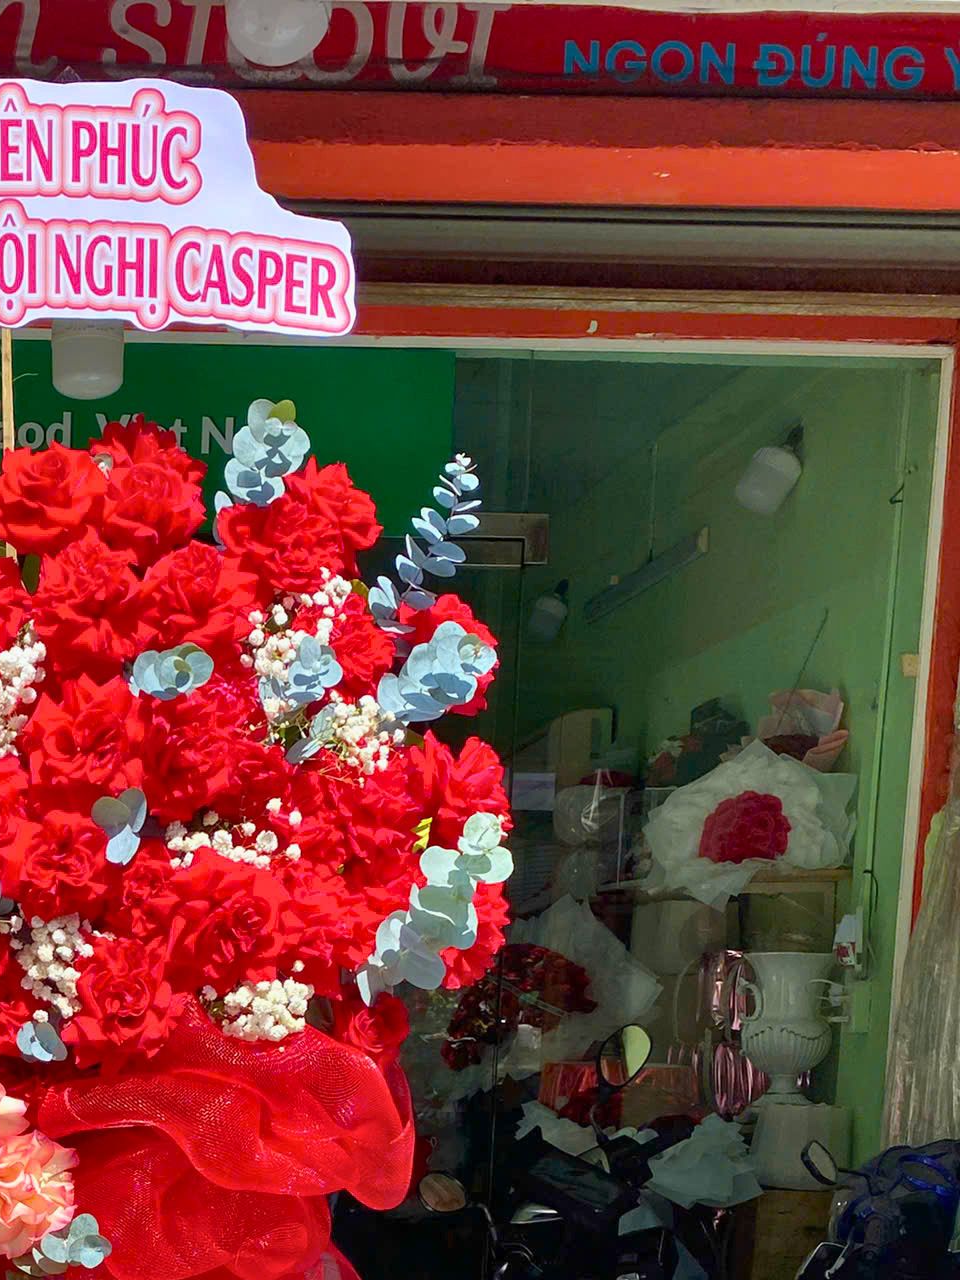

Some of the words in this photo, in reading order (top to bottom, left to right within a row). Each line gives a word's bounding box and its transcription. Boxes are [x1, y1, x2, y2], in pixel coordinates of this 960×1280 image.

[563, 39, 737, 84] NGON
[753, 32, 926, 90] ĐÚNG
[71, 103, 189, 190] PHÚC
[54, 233, 159, 316] NGHỊ
[174, 240, 337, 319] CASPER
